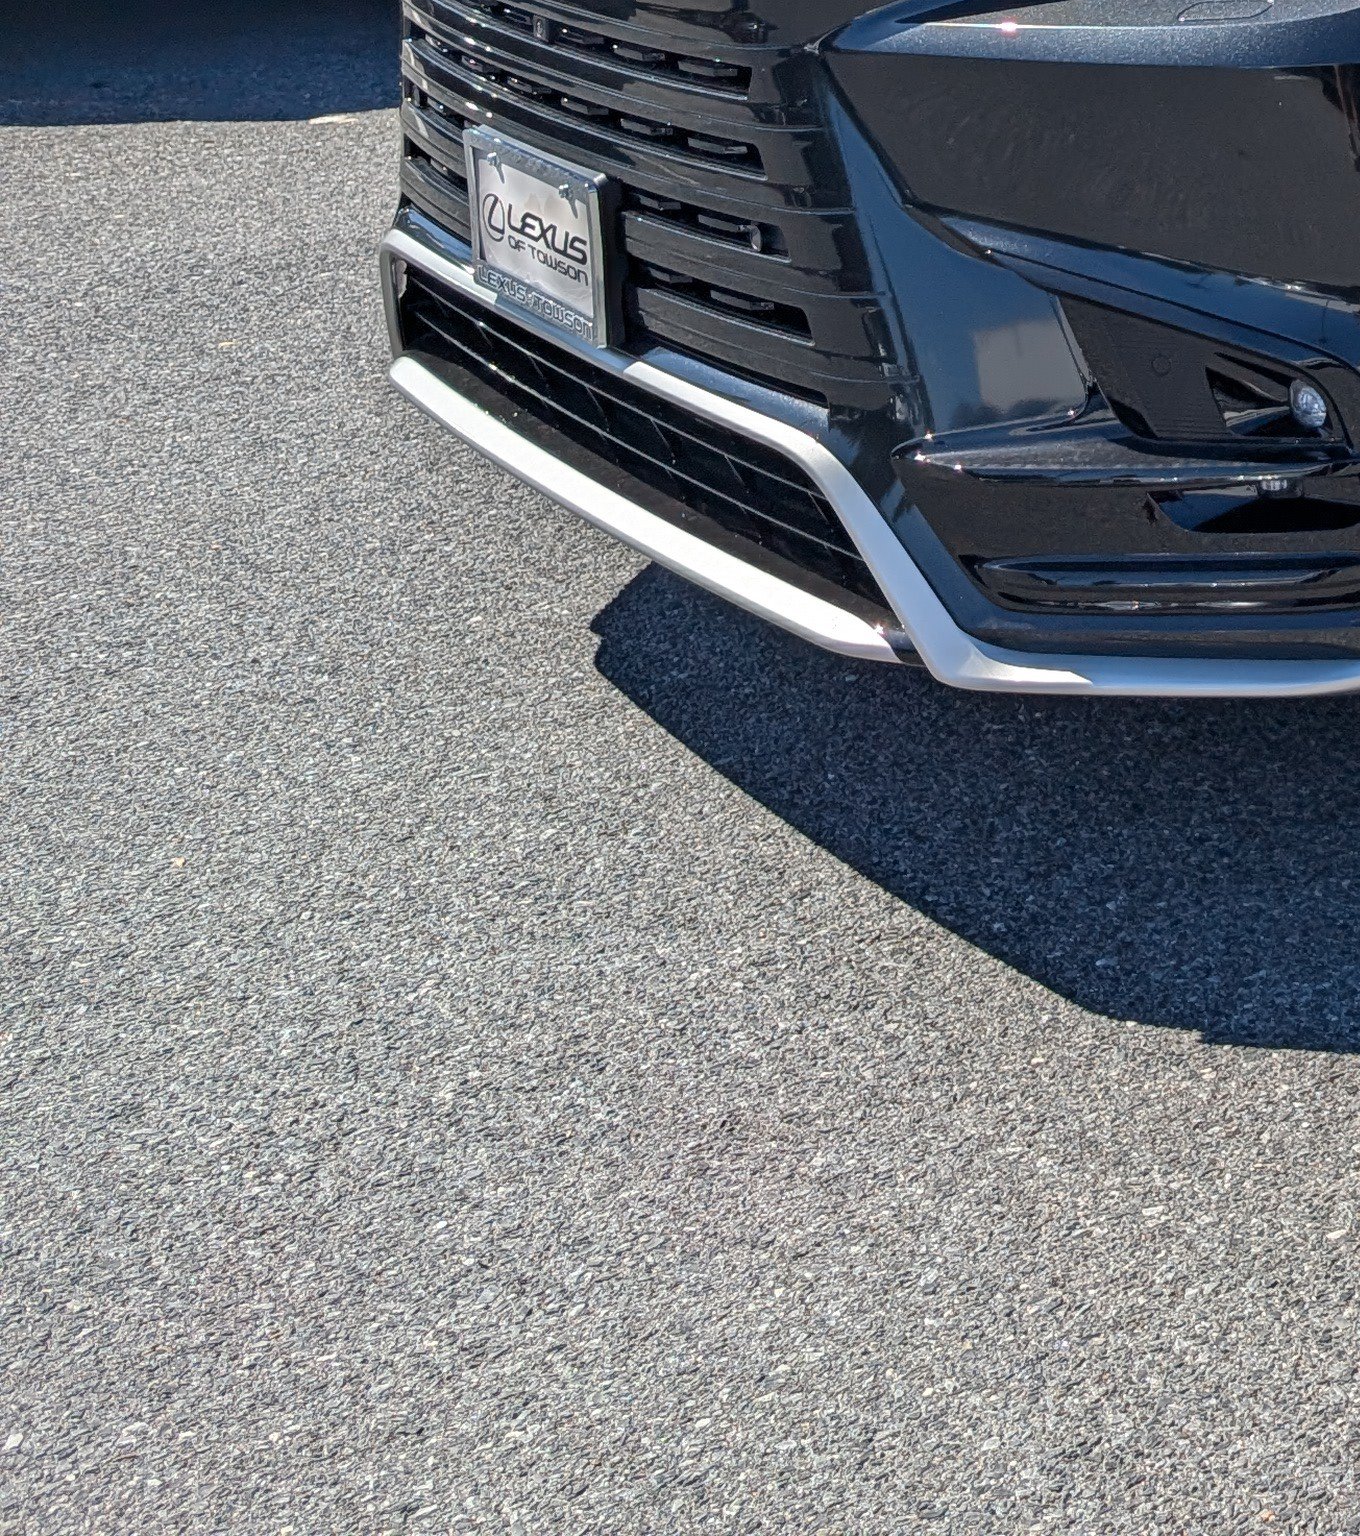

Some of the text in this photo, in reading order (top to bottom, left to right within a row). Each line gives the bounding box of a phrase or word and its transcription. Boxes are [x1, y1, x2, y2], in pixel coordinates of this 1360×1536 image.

[507, 203, 588, 265] LEXUS
[507, 235, 589, 287] OF TOWSON
[479, 266, 594, 341] LEXUS TOWSON
